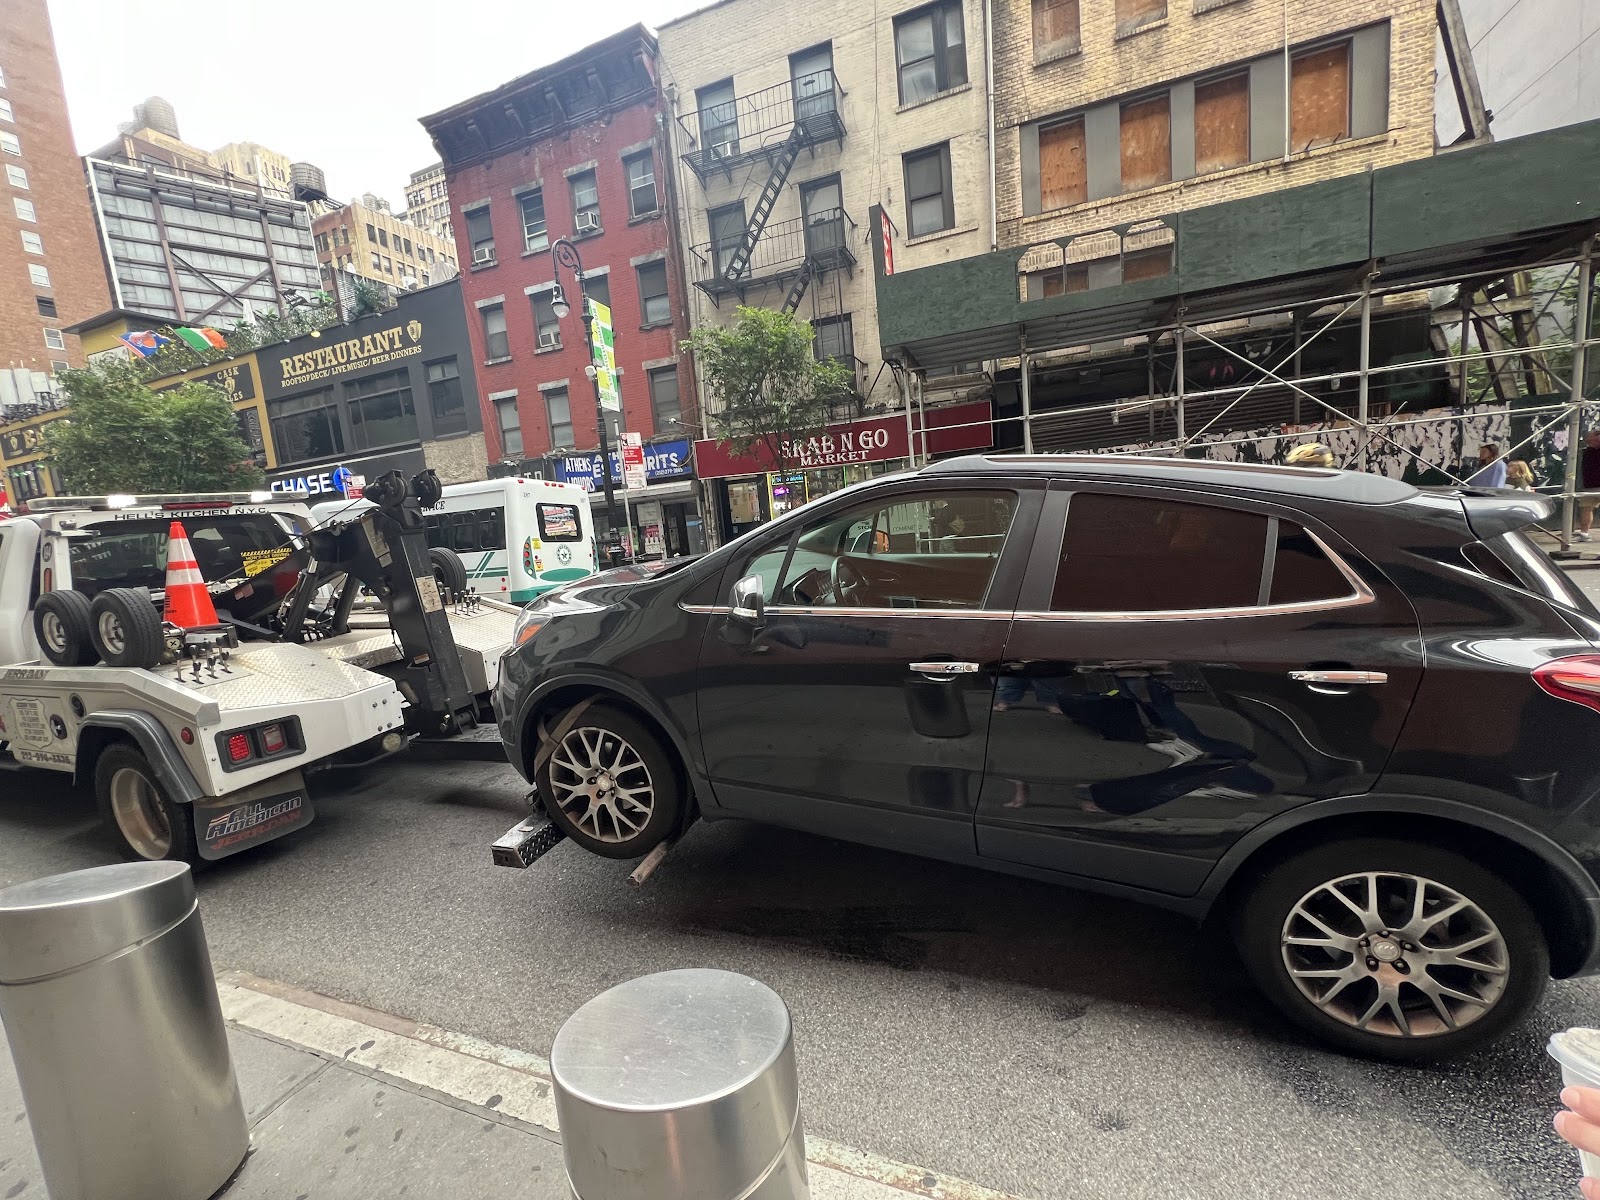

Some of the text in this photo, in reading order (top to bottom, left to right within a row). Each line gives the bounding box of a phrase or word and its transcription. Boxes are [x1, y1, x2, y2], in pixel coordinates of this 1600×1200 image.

[280, 327, 403, 378] RESTAURANT
[372, 354, 391, 365] BEER
[391, 345, 422, 359] DINNERS
[217, 366, 239, 380] CASK
[840, 432, 853, 452] N
[859, 428, 888, 450] GO
[565, 457, 592, 473] ATHENS
[800, 450, 869, 467] MARKET
[271, 472, 333, 495] CHASE
[114, 506, 270, 521] HELL'S KITCHEN N.Y.C.
[206, 796, 301, 840] AMERICAN
[228, 803, 266, 823] ALL
